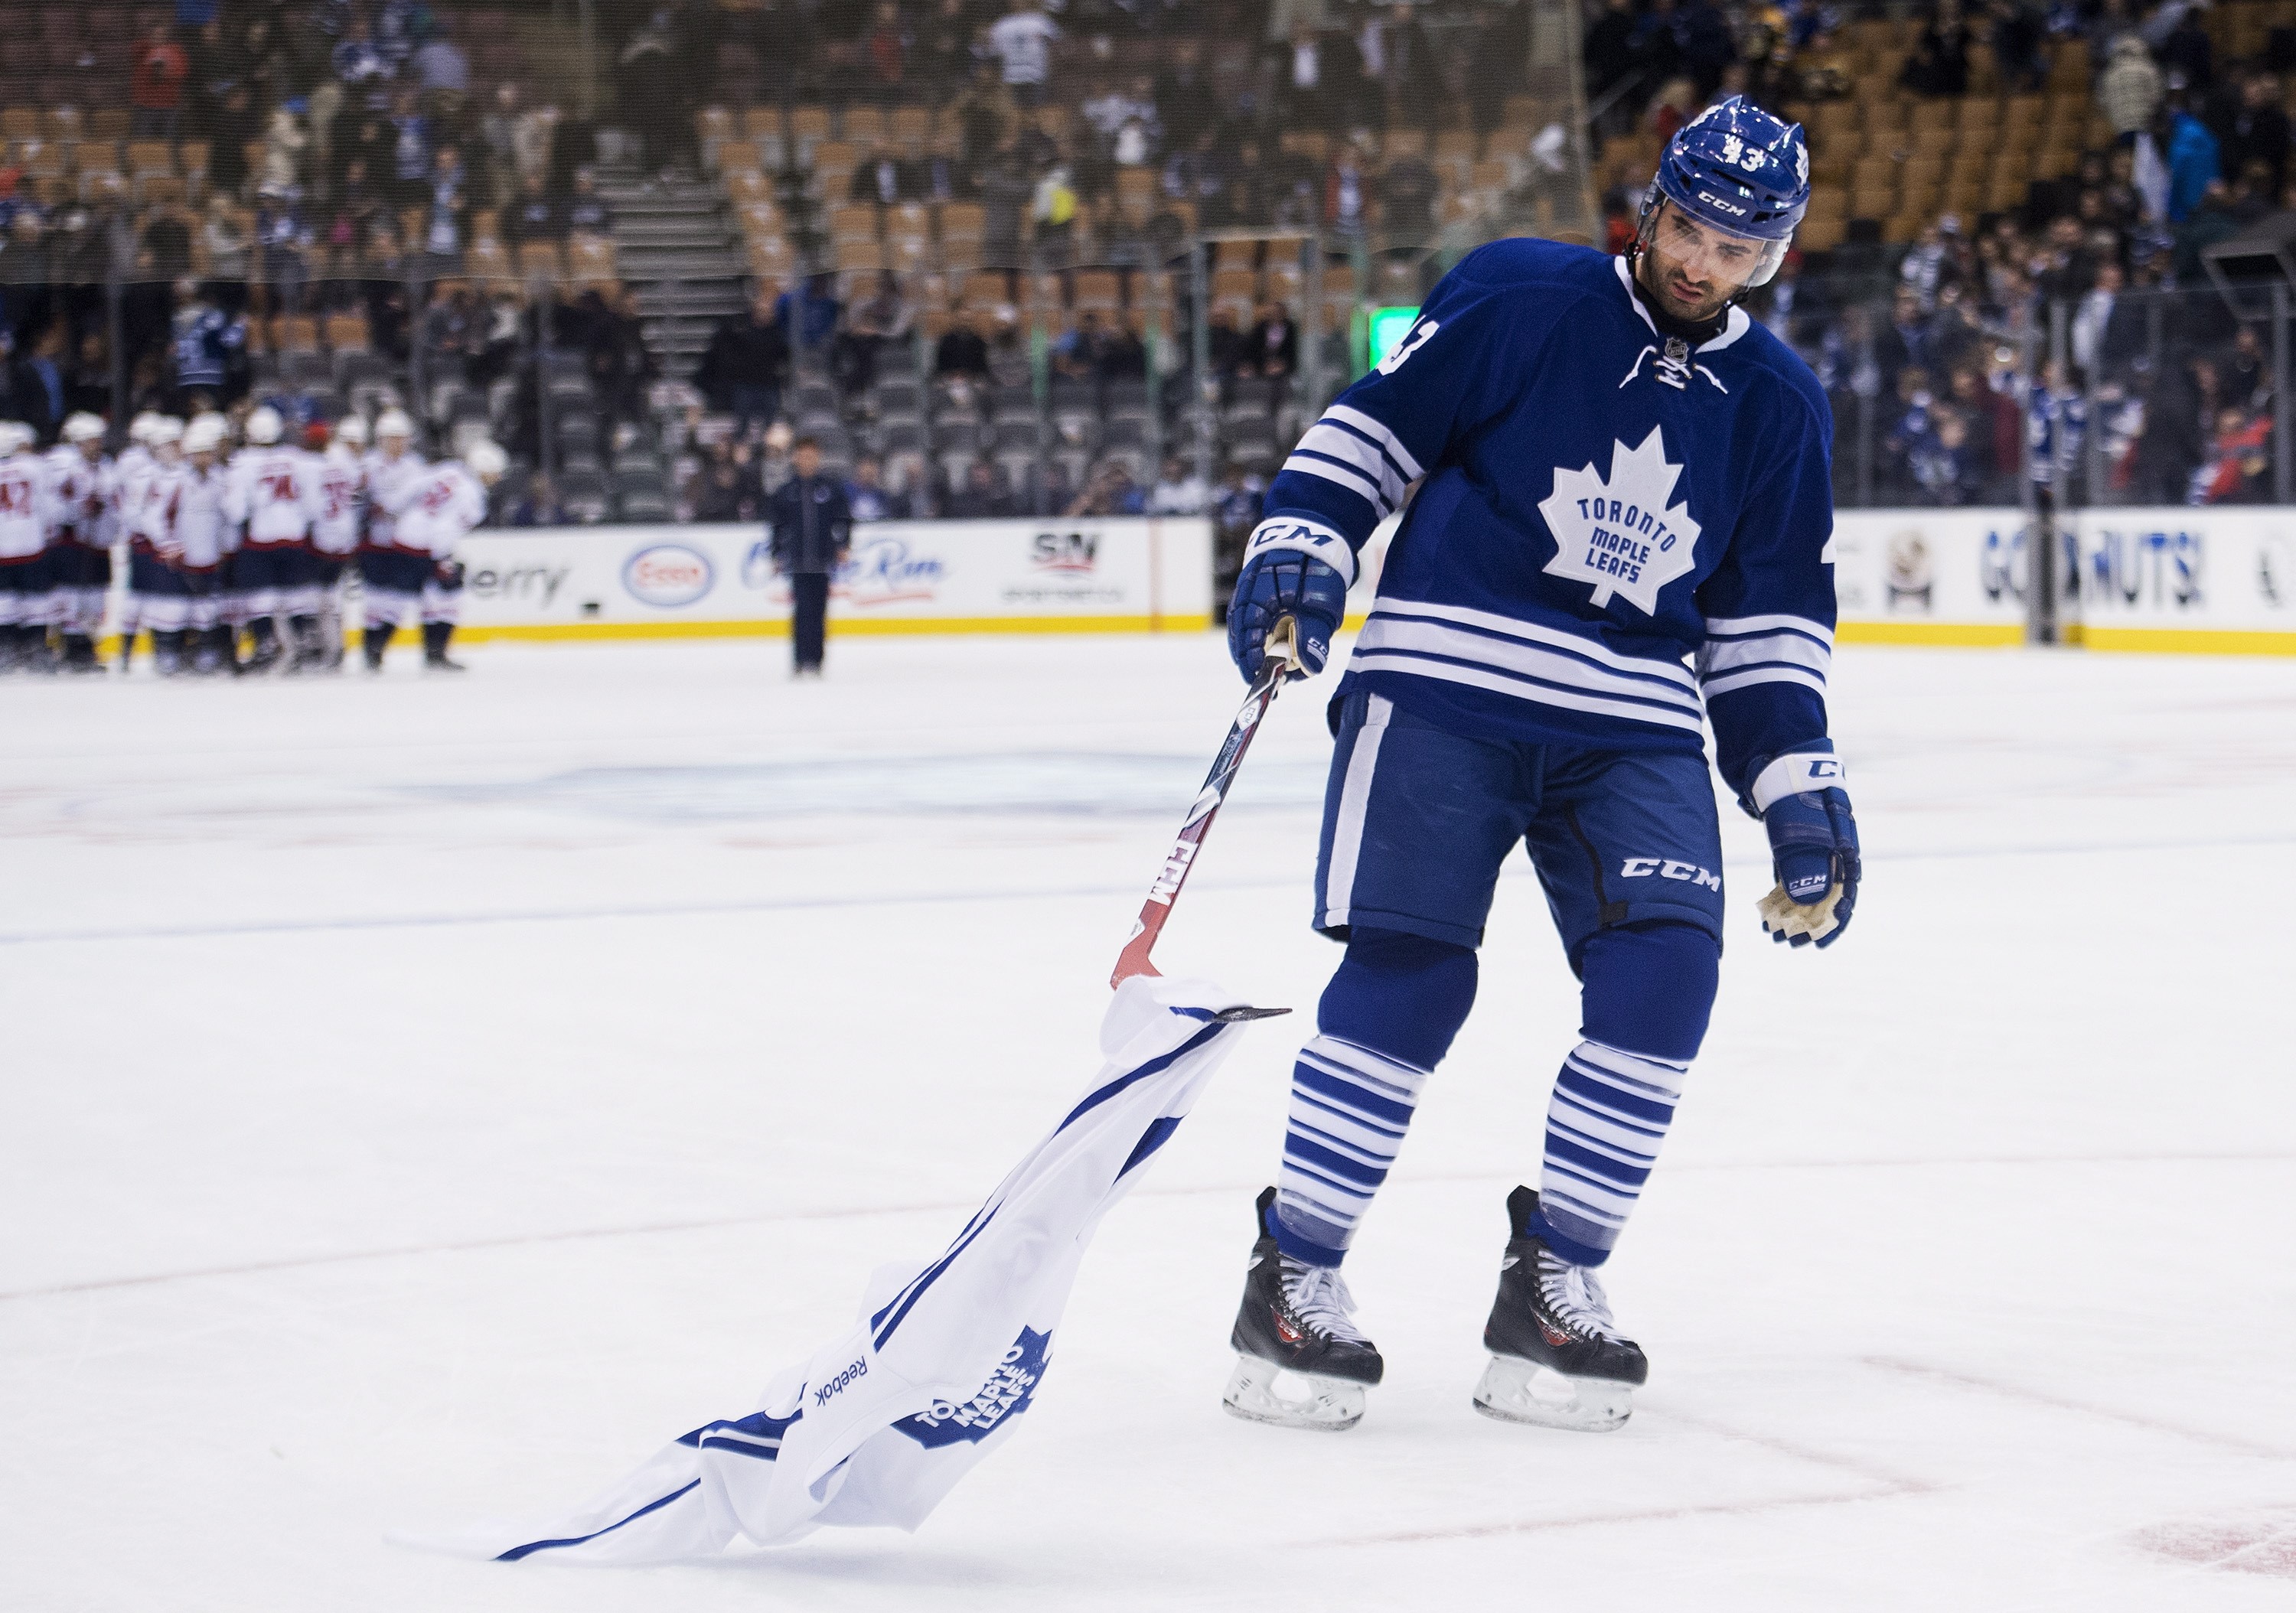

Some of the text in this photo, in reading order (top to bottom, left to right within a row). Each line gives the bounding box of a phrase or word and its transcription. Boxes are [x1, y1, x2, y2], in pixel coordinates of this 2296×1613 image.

[1722, 135, 1763, 172] 43
[1697, 190, 1746, 217] CCM
[1375, 314, 1440, 376] 3
[1248, 524, 1334, 548] CM
[1577, 497, 1677, 552] TORONTO
[1590, 526, 1651, 565] MAPLE
[1584, 548, 1641, 584] LEAFS
[1242, 707, 1256, 724] CCM
[1149, 839, 1199, 906] CCM
[1621, 858, 1721, 893] CCM
[1789, 875, 1827, 891] CCM
[814, 1355, 868, 1406] Reebok
[972, 1373, 1035, 1429] LEAFS
